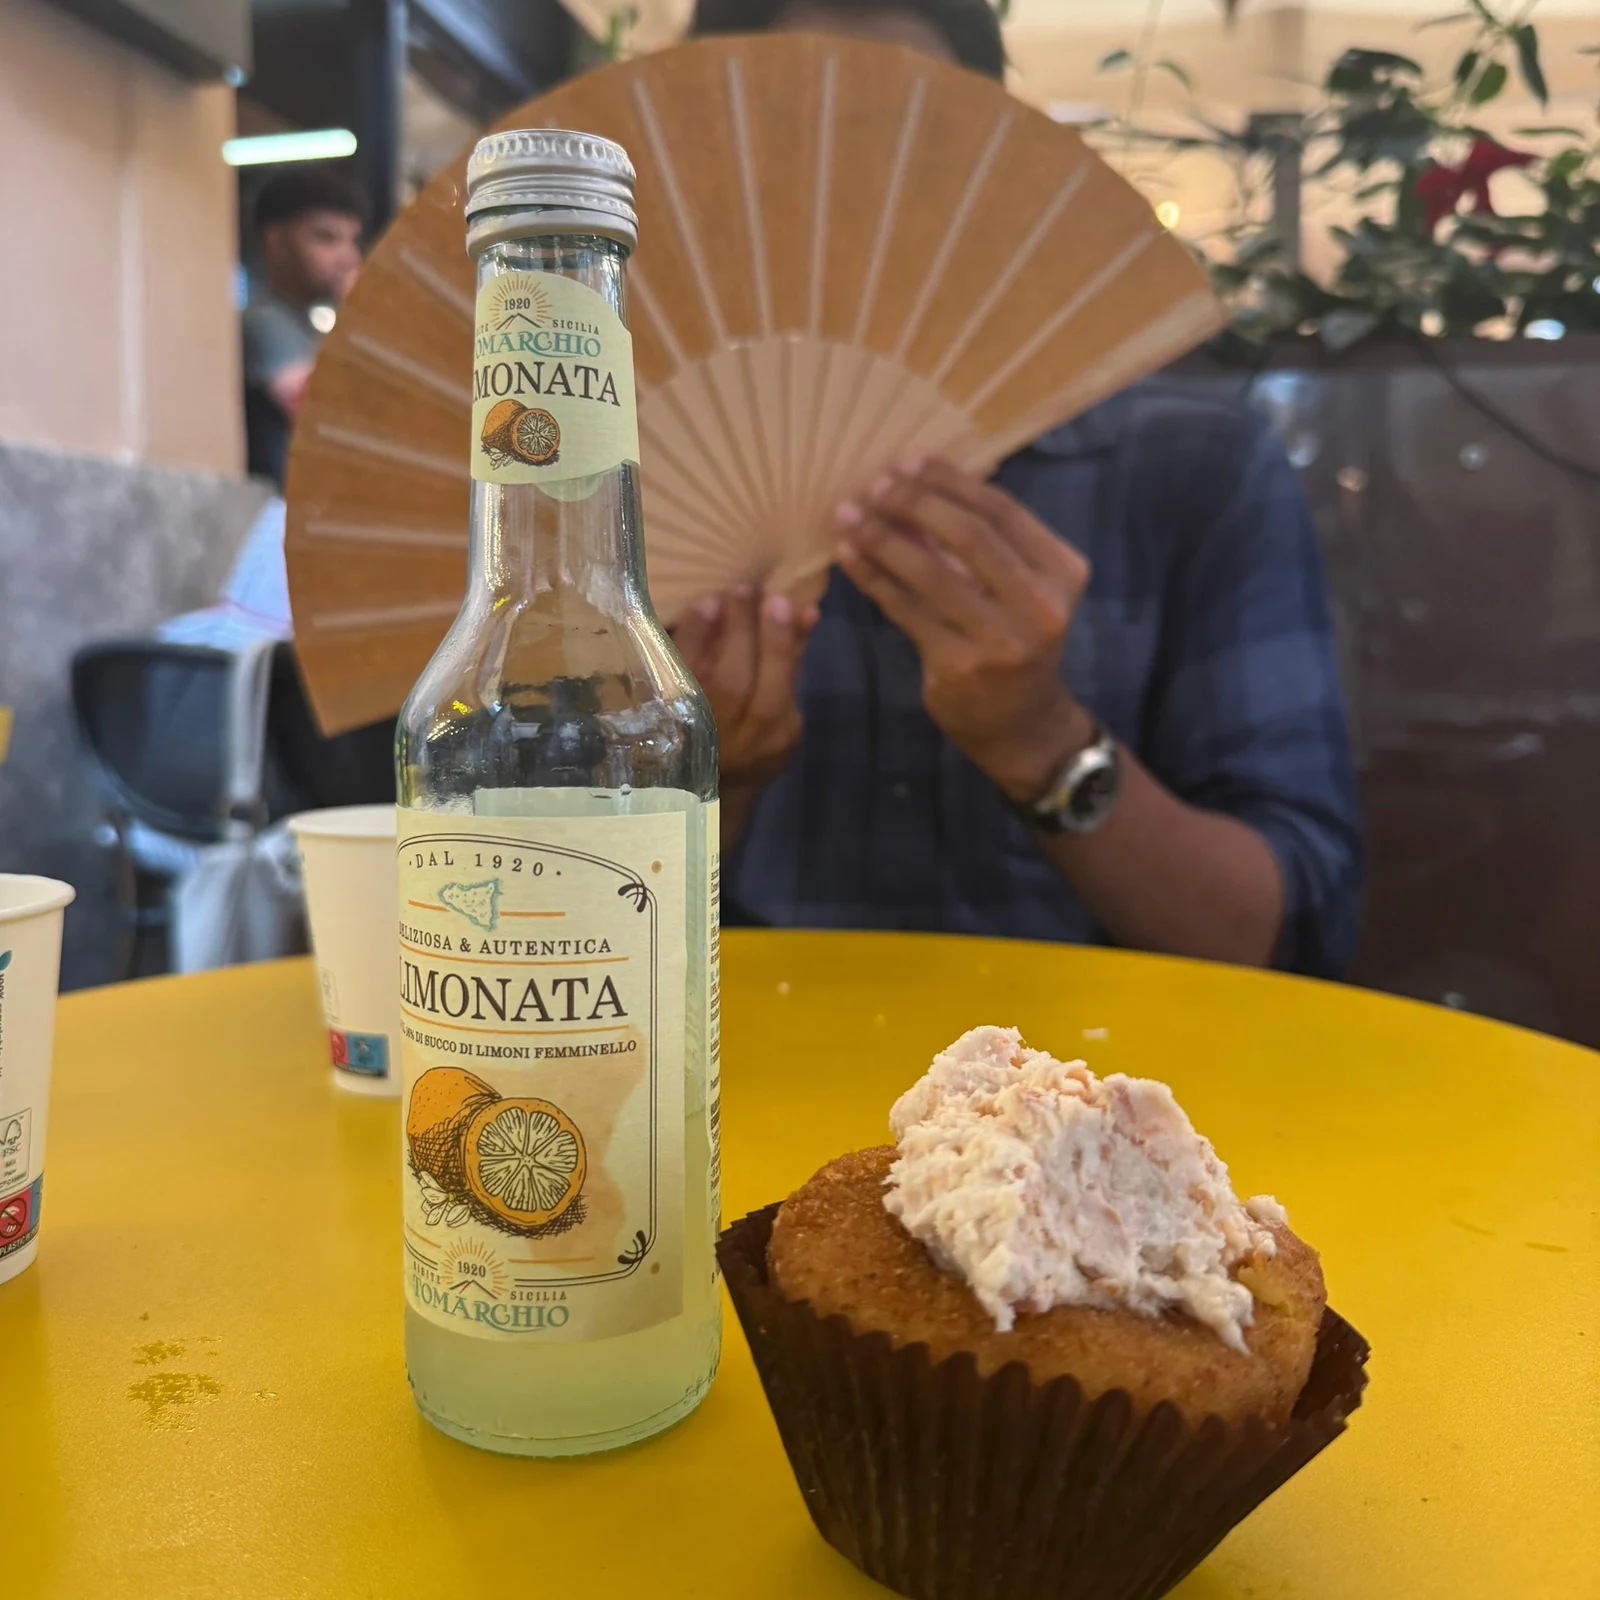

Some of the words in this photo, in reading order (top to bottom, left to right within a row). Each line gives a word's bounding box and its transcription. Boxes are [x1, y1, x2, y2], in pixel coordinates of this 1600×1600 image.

[504, 298, 531, 311] 1920
[552, 319, 600, 335] SICILIA
[415, 851, 454, 869] DAL
[475, 853, 544, 877] 1920
[459, 937, 472, 953] &
[479, 938, 612, 956] AUTENTICA
[415, 1031, 424, 1045] DI
[424, 1034, 457, 1053] SUCCO
[459, 1042, 473, 1055] DI
[476, 1044, 530, 1059] LIMONI
[534, 1040, 637, 1059] FEMMINELLO
[458, 1261, 486, 1278] 1920
[413, 1274, 570, 1333] TOMARCHIO
[510, 1290, 567, 1302] SICILIA
